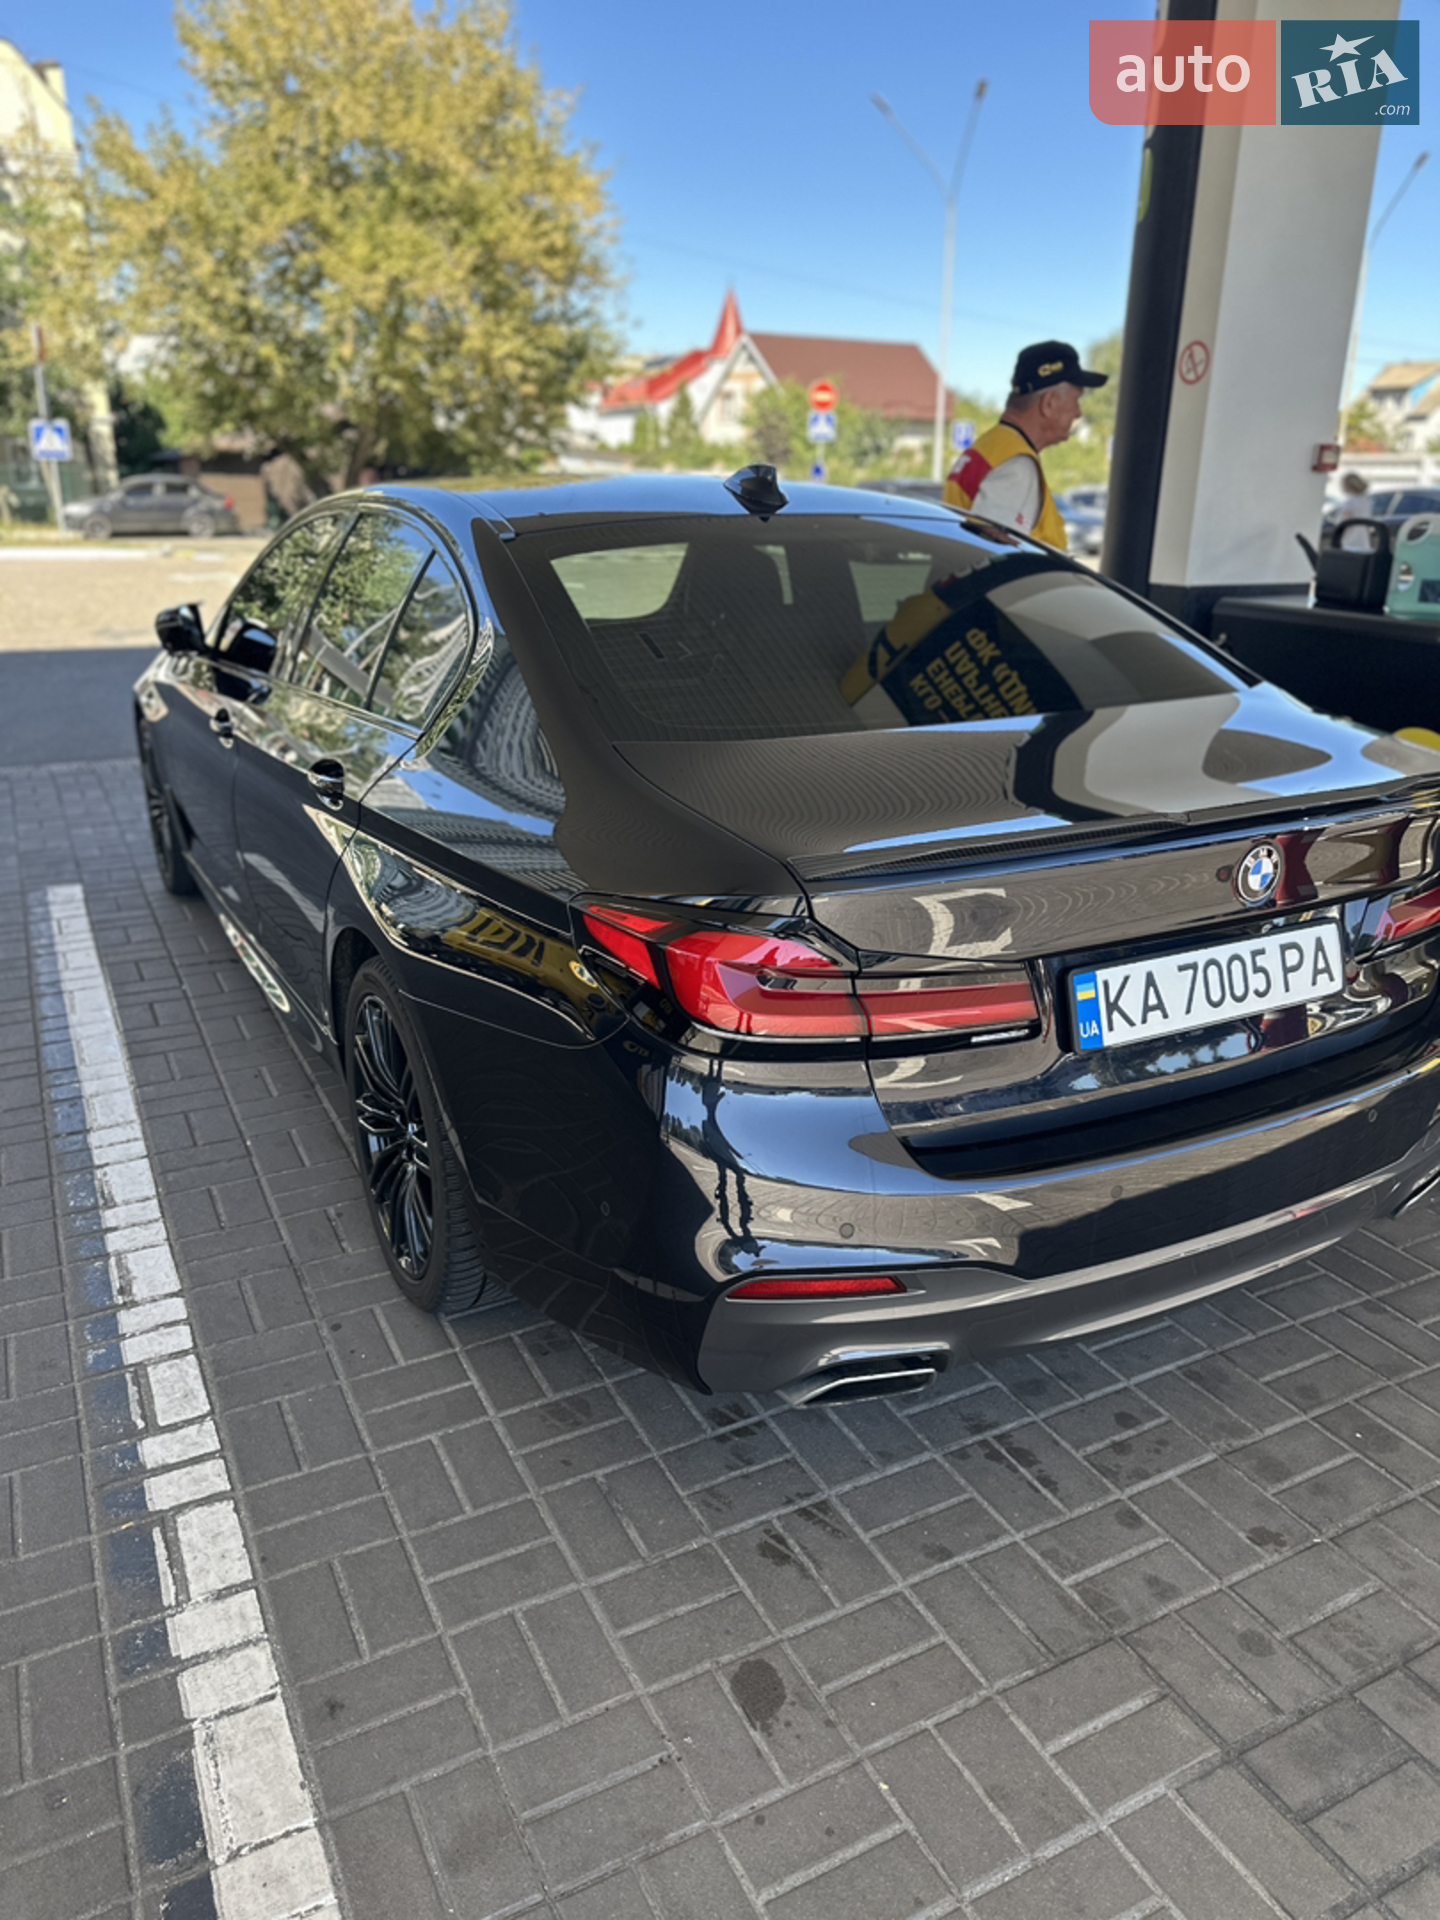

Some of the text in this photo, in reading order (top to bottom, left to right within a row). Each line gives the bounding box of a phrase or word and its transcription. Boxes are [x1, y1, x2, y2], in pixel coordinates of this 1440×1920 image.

[1102, 936, 1335, 1032] KA 7005 PA
[1079, 1022, 1100, 1039] UA
